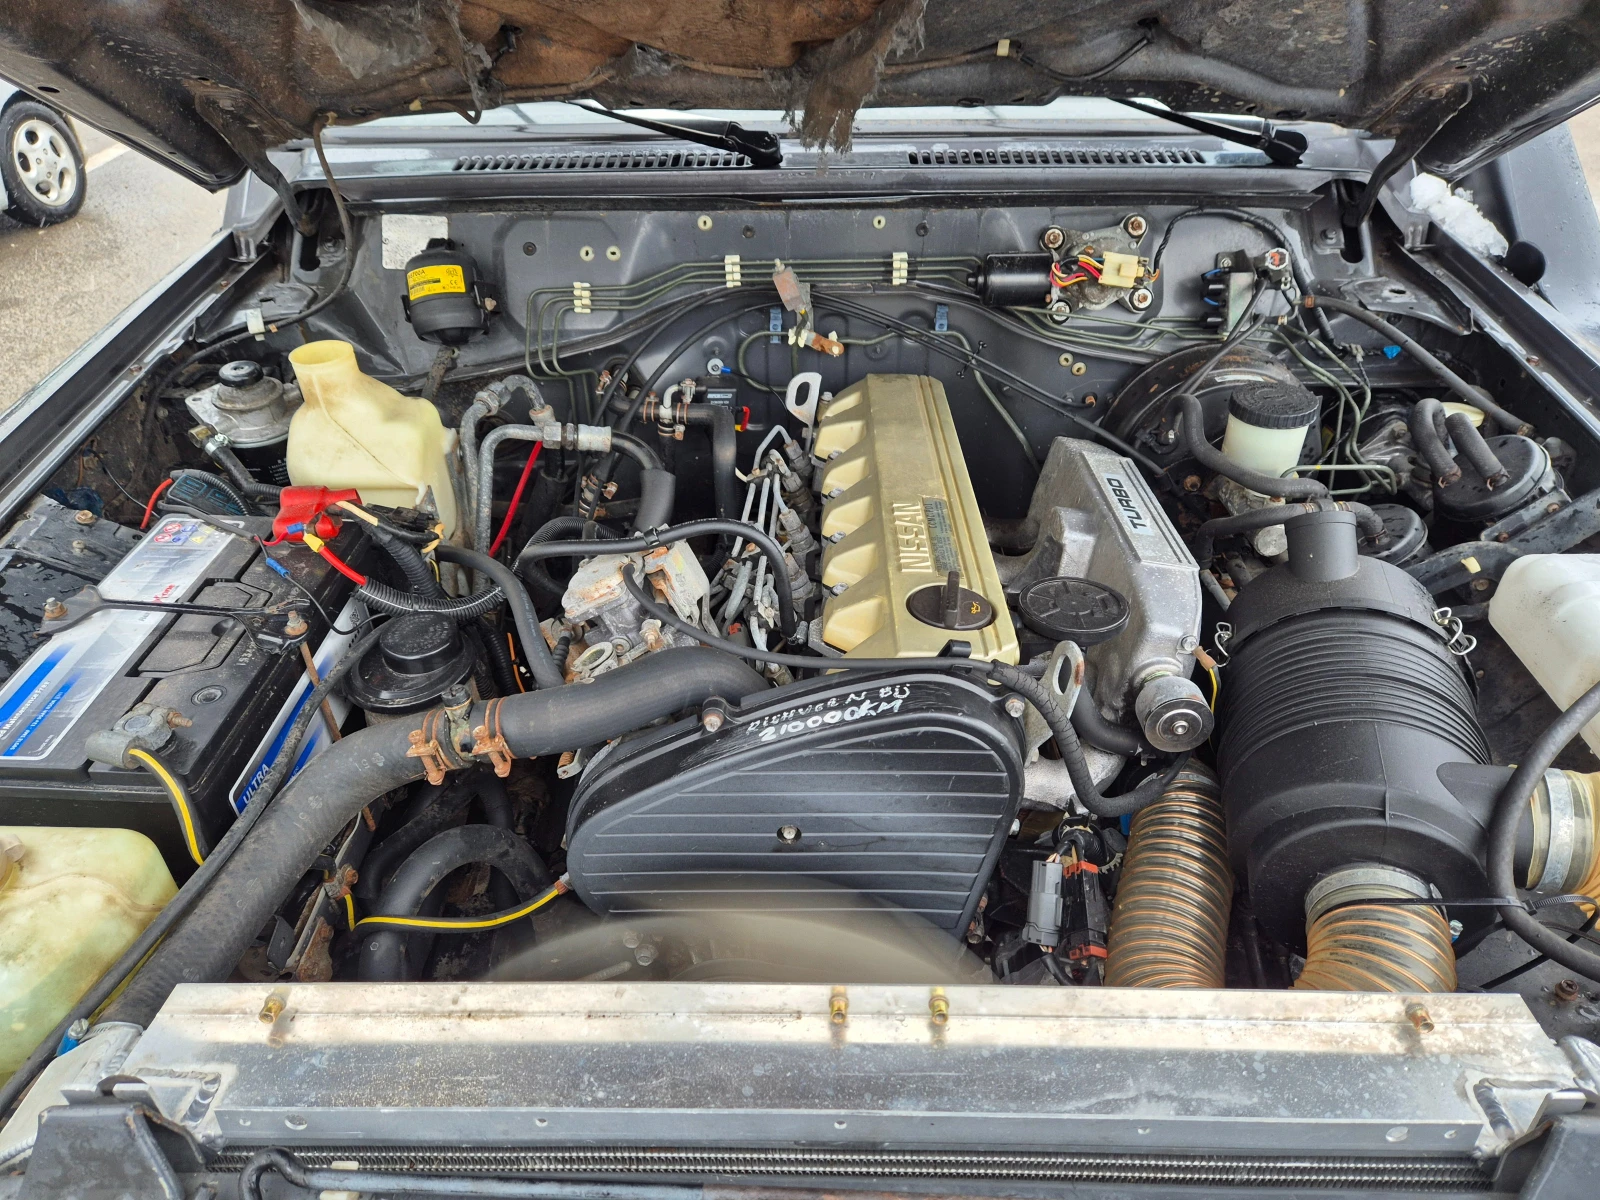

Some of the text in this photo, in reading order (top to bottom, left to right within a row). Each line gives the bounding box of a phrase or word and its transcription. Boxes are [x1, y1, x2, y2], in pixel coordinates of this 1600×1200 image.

[1106, 477, 1147, 530] TURBO
[892, 501, 933, 573] NISSAN
[242, 763, 270, 804] ULTRA
